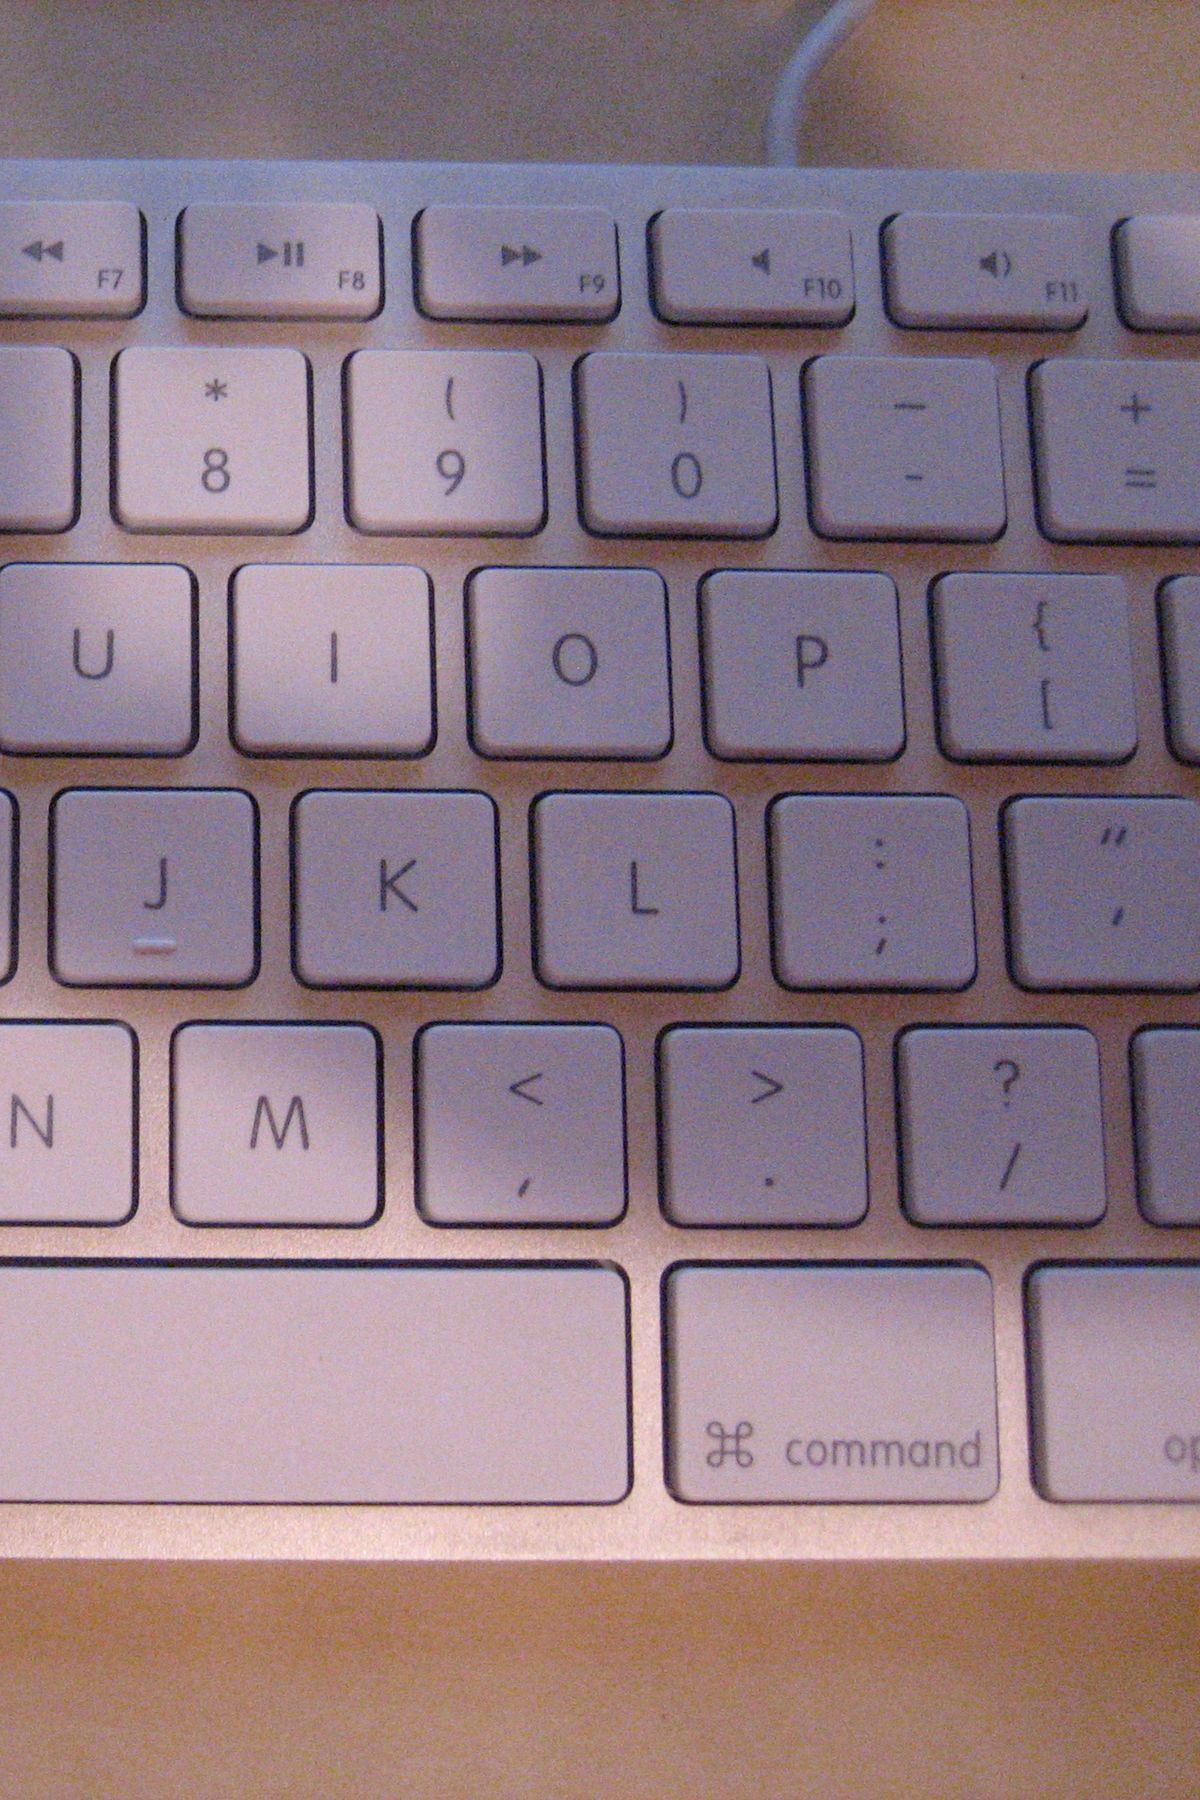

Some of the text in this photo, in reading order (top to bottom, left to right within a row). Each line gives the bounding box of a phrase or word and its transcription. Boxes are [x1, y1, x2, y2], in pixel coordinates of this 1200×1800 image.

[96, 268, 124, 290] F7
[337, 270, 366, 291] F8
[578, 273, 606, 294] F9
[803, 277, 843, 300] F10
[1044, 281, 1078, 302] F11
[444, 376, 456, 421] (
[677, 380, 689, 424] )
[1120, 392, 1152, 424] +
[200, 447, 232, 494] 8
[435, 448, 467, 497] 9
[1124, 467, 1157, 490] =
[72, 627, 115, 681] U
[551, 632, 599, 687] O
[795, 634, 830, 689] P
[143, 857, 168, 911] J
[379, 858, 419, 913] K
[629, 860, 660, 916] L
[874, 915, 888, 956] ;
[508, 1072, 544, 1106] <
[751, 1070, 784, 1105] >
[993, 1058, 1021, 1107] ?
[9, 1093, 55, 1149] N
[248, 1094, 310, 1151] M
[999, 1142, 1022, 1191] /
[784, 1430, 982, 1469] command
